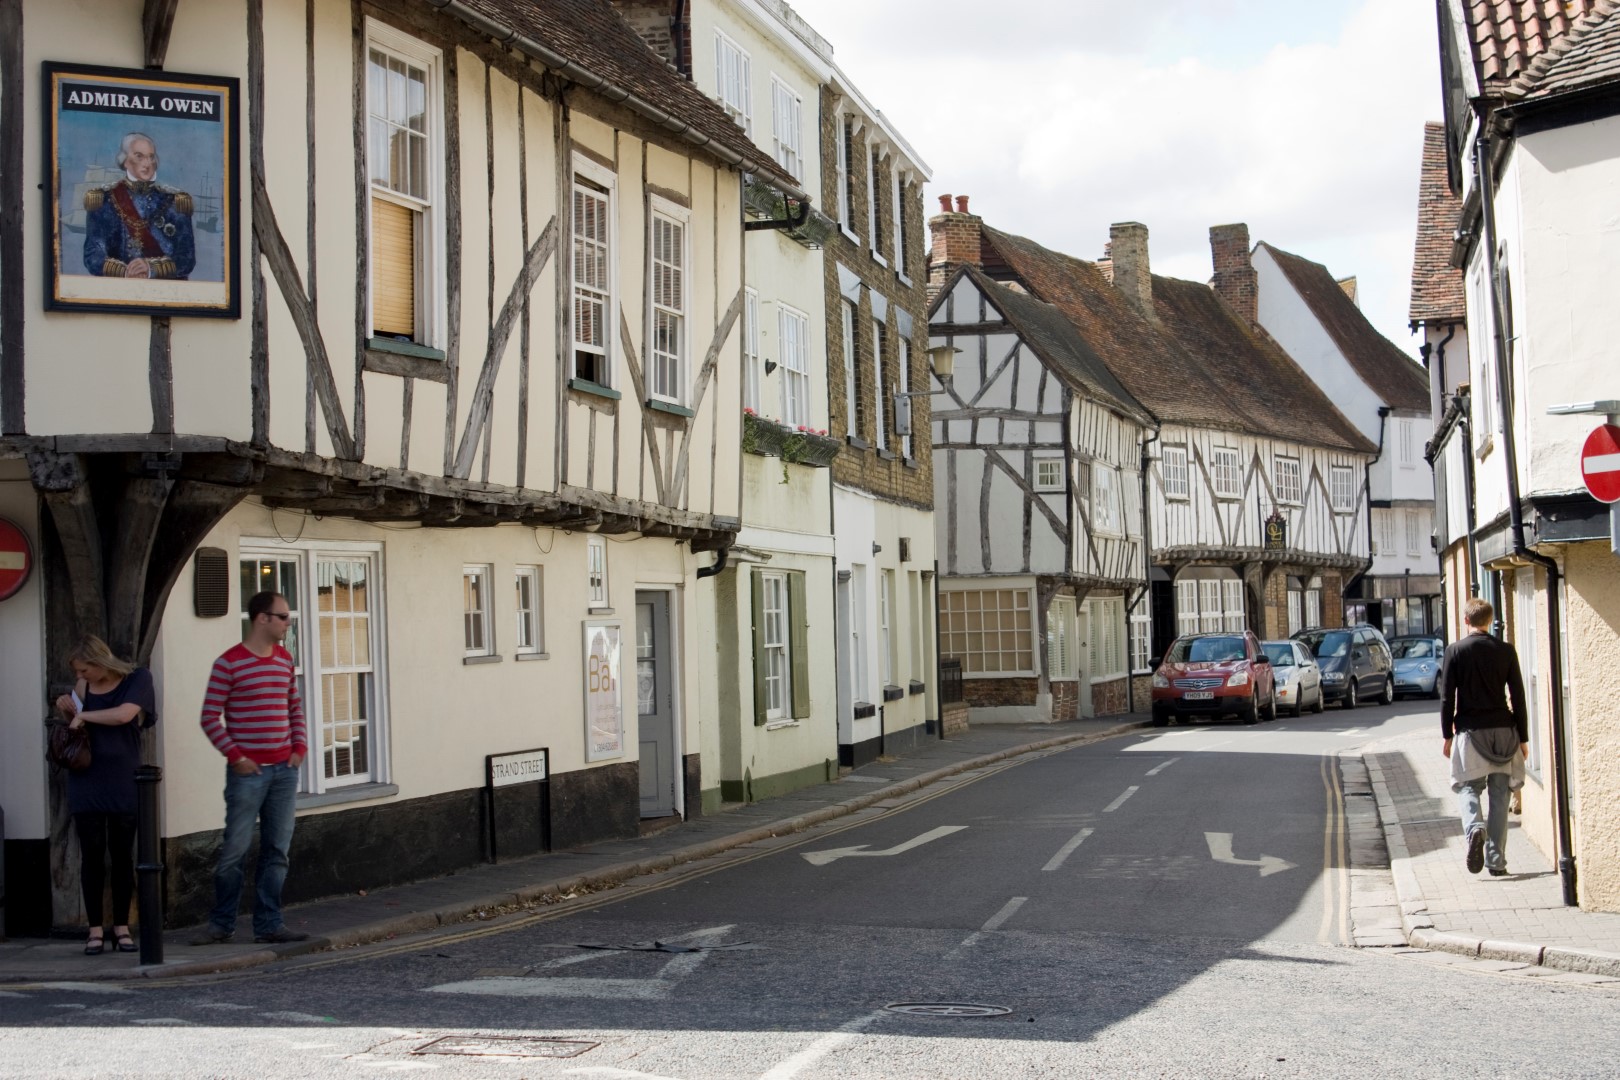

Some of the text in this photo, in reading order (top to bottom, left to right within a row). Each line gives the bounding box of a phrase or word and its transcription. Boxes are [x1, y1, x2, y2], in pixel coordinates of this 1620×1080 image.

[67, 91, 214, 115] ADMIRAL OWEN
[492, 758, 544, 779] STRAND STREET
